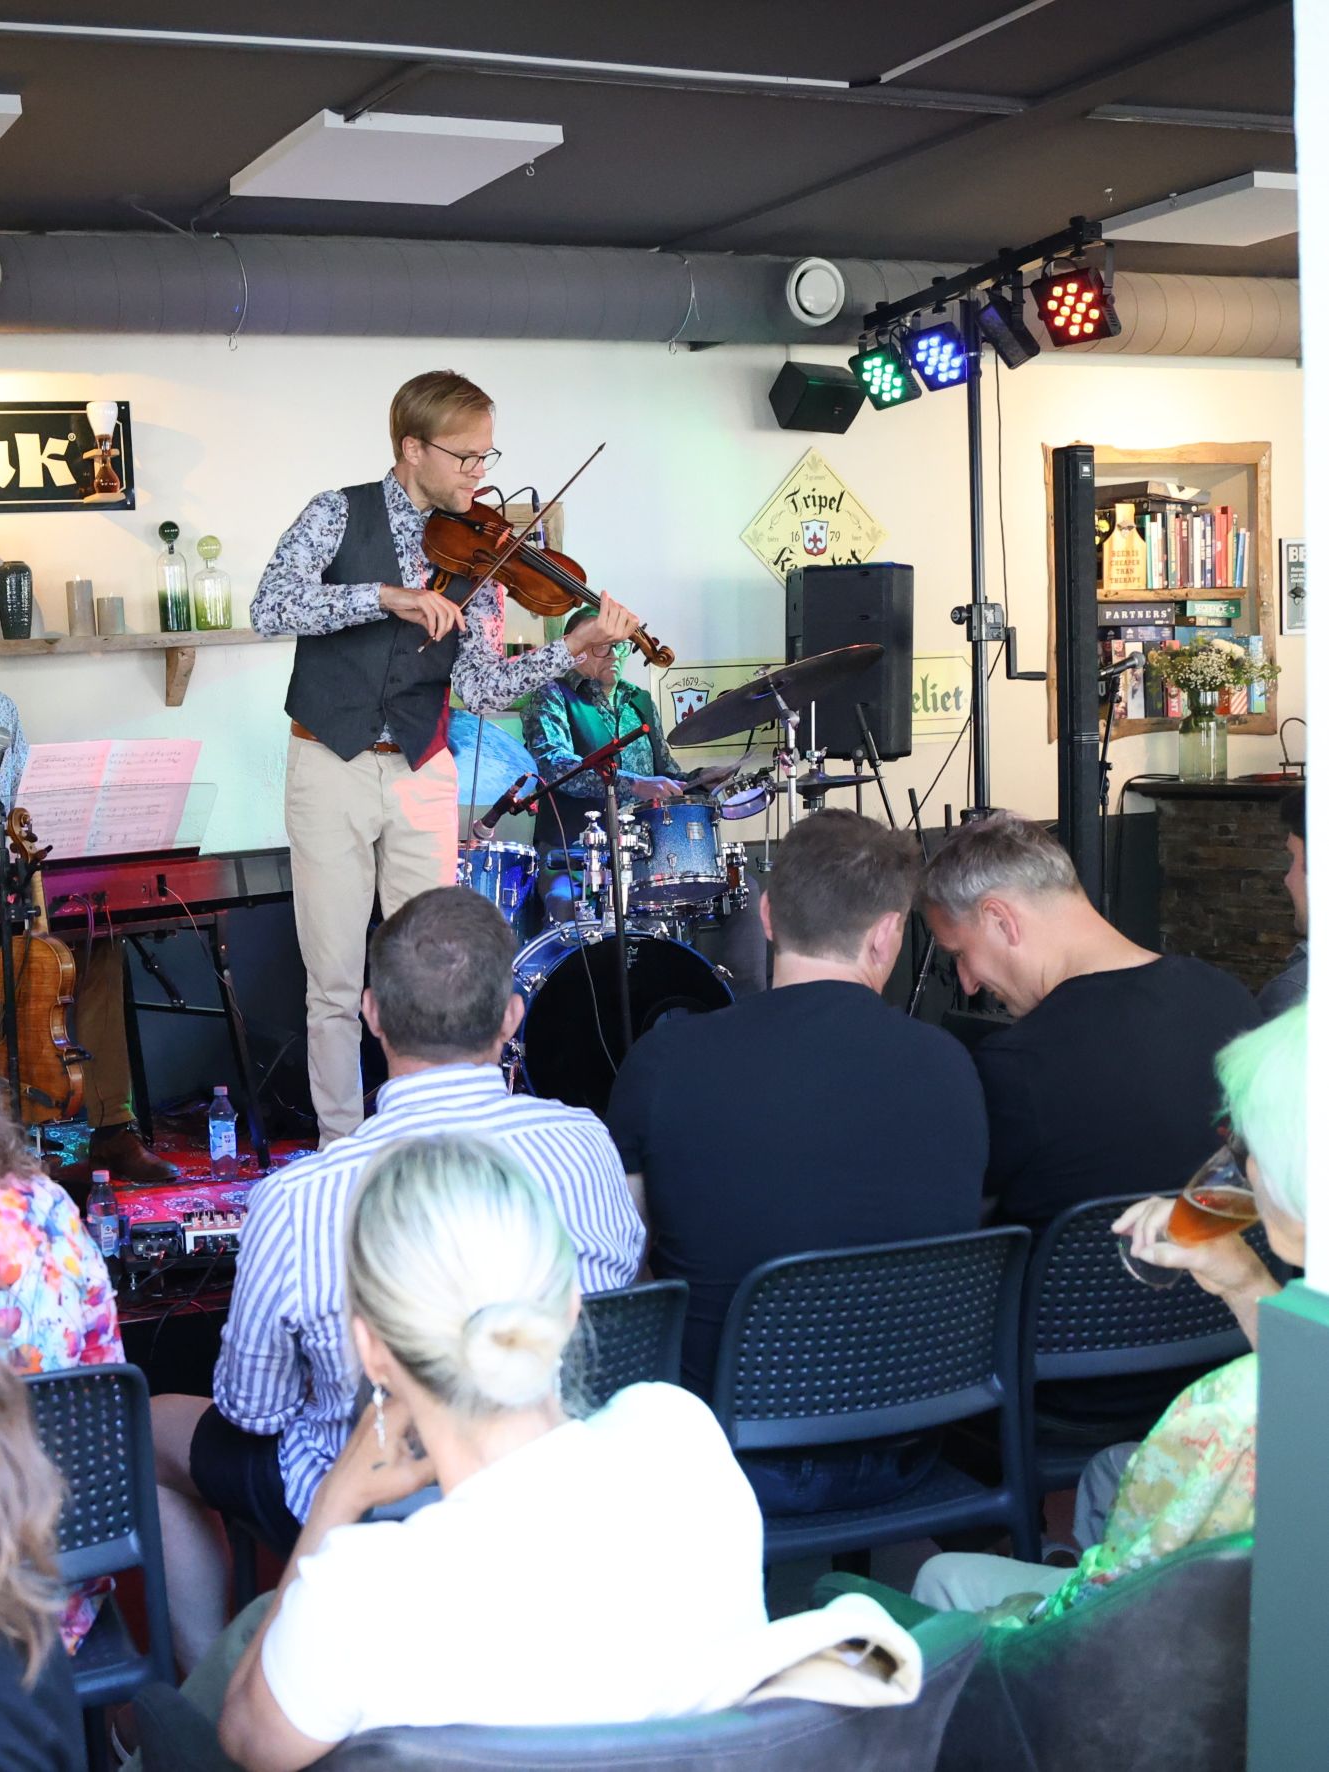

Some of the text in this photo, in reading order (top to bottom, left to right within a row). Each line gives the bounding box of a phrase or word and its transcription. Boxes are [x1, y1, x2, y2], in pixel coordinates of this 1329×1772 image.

[784, 486, 845, 515] Tripel
[791, 531, 800, 542] 16
[829, 531, 841, 542] 79
[681, 677, 699, 687] 1679
[912, 673, 963, 713] eliet
